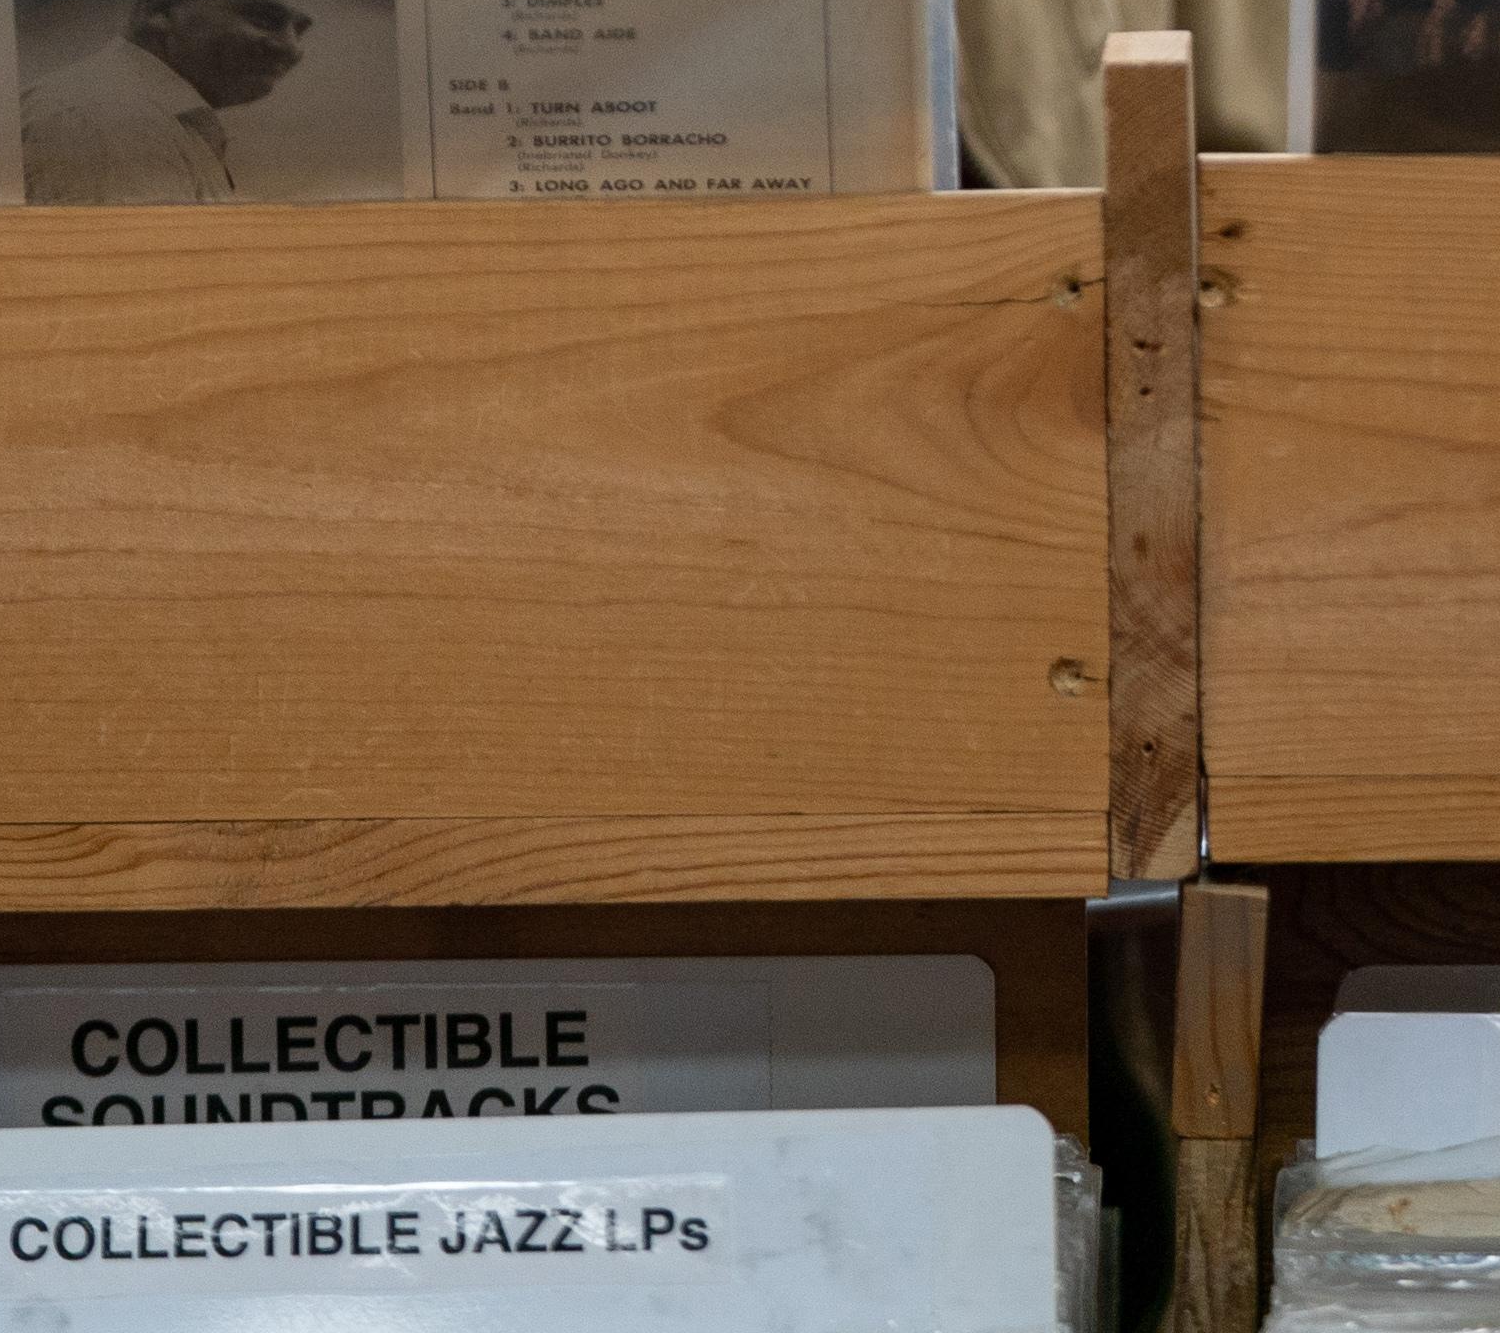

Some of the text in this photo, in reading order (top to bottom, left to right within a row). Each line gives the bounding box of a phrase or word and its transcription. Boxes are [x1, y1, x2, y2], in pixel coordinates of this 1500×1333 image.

[528, 28, 583, 41] BAND
[593, 27, 637, 40] AIDE
[449, 78, 510, 91] SIDE B
[449, 102, 495, 116] Band
[529, 100, 580, 114] TURN
[532, 133, 612, 147] BURRITO
[621, 132, 728, 146] BORRACHO
[535, 178, 589, 192] LONG
[599, 178, 644, 192] AGO
[653, 178, 696, 191] AND
[706, 177, 742, 191] FAR
[751, 177, 813, 190] AWAY
[70, 1009, 589, 1077] COLLECTIBLE
[9, 1207, 710, 1262] COLLECTIBLE JAZZ LPs
